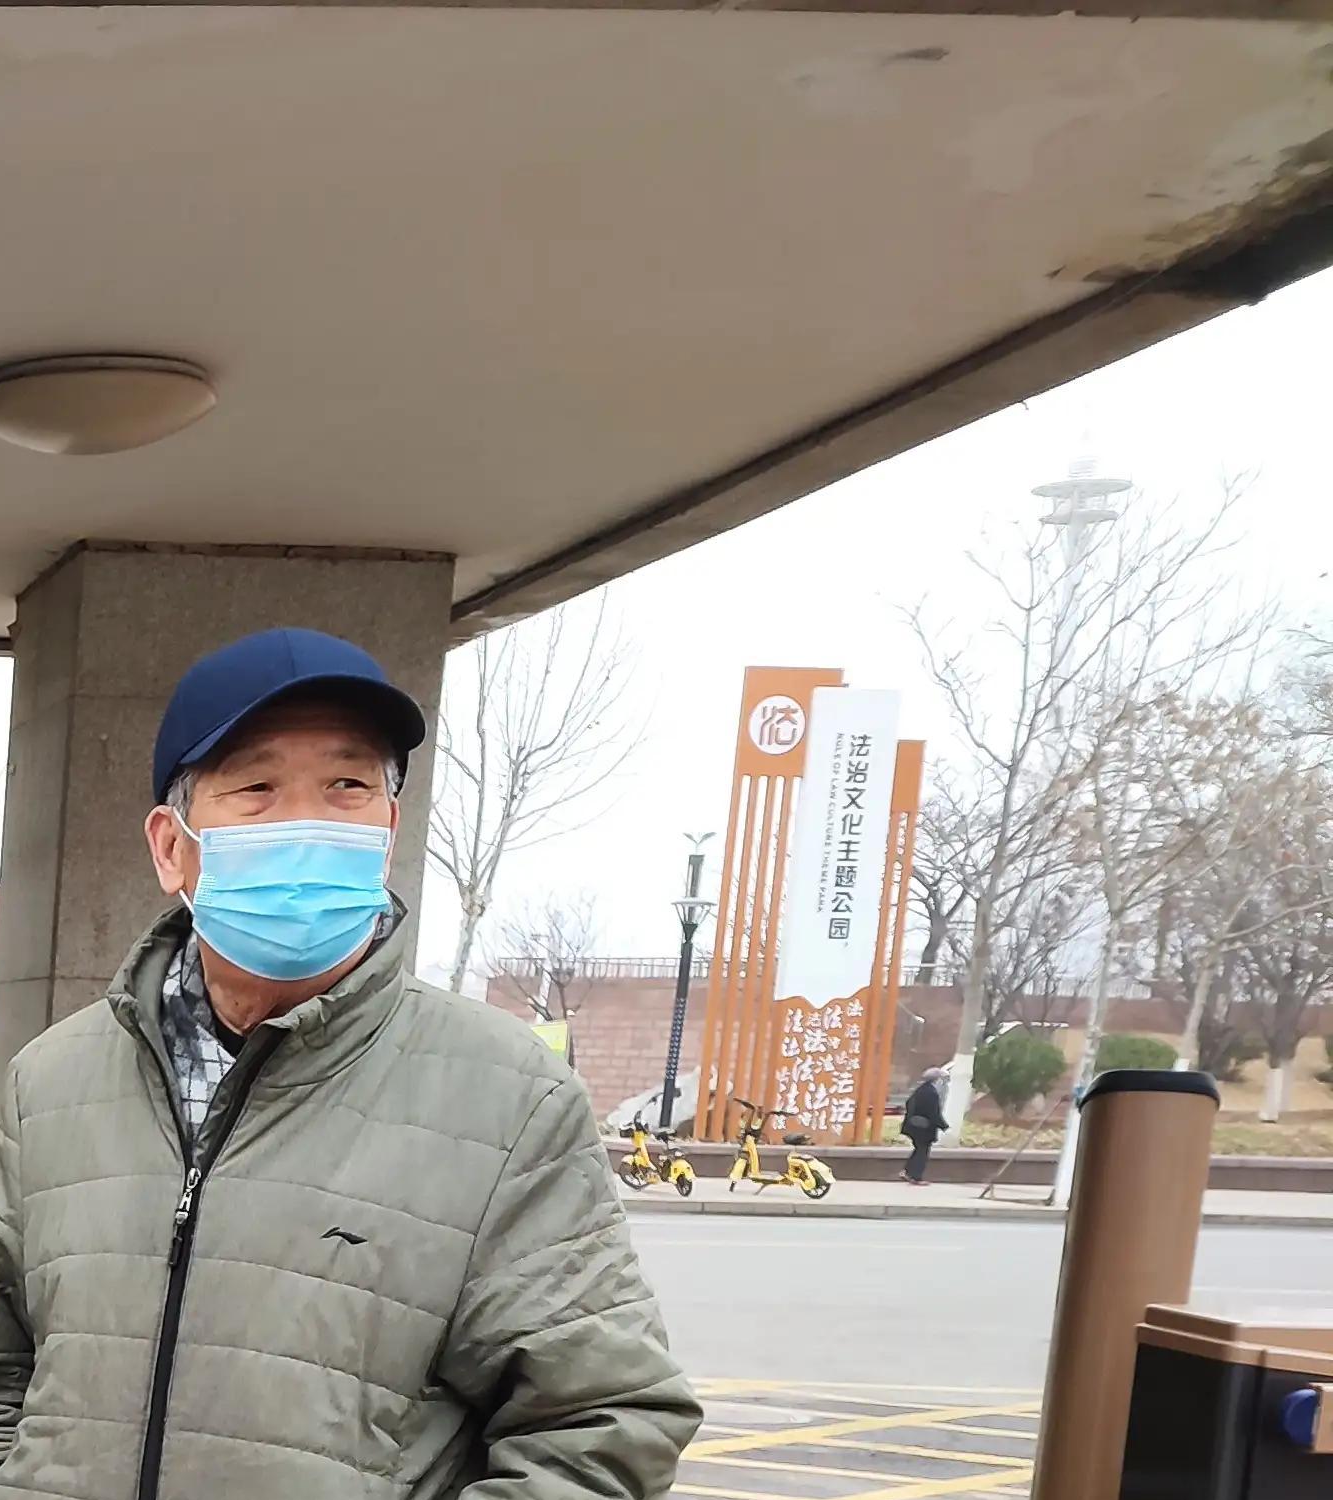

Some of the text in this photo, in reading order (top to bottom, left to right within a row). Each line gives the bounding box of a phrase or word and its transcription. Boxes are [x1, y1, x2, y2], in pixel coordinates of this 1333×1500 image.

[828, 733, 872, 940] 法治文化主题公园
